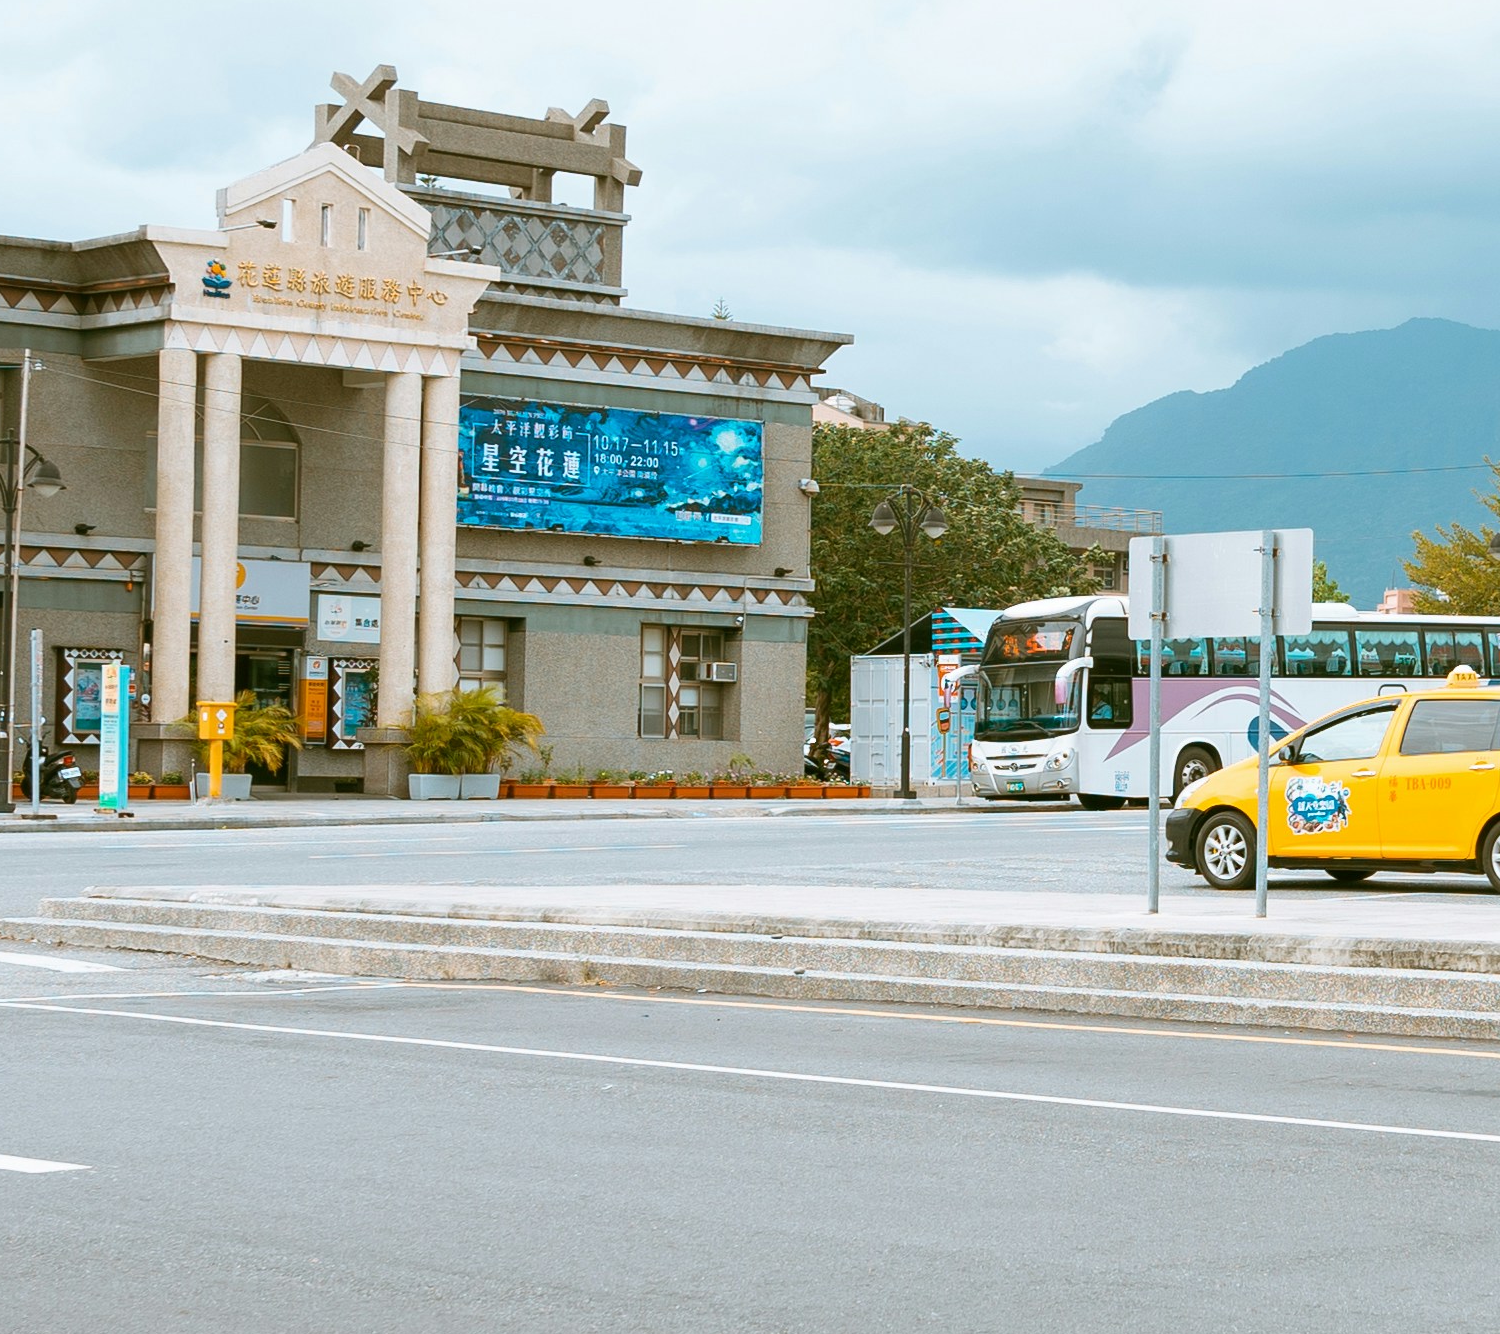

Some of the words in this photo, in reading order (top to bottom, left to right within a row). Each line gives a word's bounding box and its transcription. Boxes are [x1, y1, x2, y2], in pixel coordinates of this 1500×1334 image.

[237, 260, 449, 307] 花蓮縣旅遊服務中心
[481, 443, 581, 479] 星空花蓮
[1454, 673, 1477, 681] TAXI
[1405, 777, 1453, 791] TBA-009
